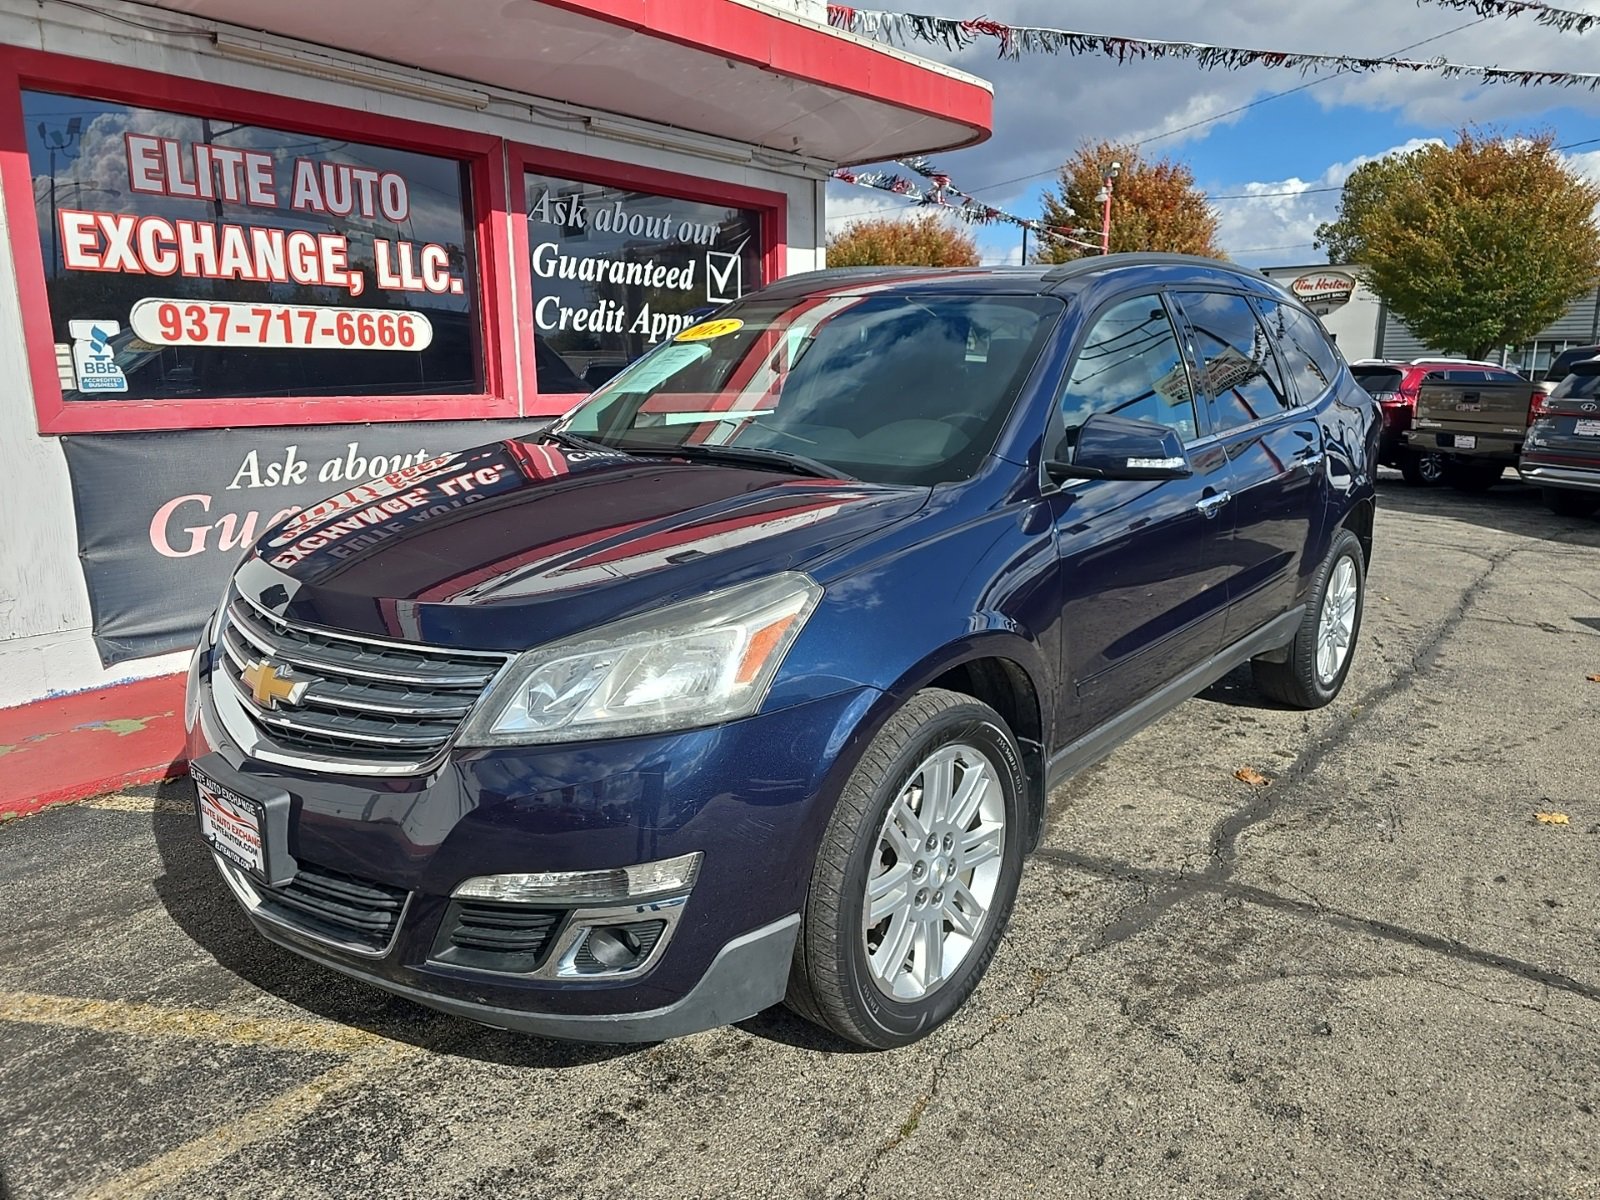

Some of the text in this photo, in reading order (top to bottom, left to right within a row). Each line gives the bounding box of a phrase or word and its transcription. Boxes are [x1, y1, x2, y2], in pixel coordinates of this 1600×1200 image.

[125, 132, 409, 223] ELITE AUTO
[527, 189, 721, 246] Ask about our
[58, 208, 464, 296] EXCHANGE, LLC.
[532, 242, 696, 291] Guaranteed
[1295, 278, 1314, 291] Tim
[157, 306, 416, 348] 937-717-6666
[535, 295, 625, 333] Credit
[84, 362, 118, 374] BBB
[1455, 403, 1482, 412] GMC
[226, 442, 430, 490] Ask about
[190, 768, 256, 815] ELITE AUTO EXCHANGE
[201, 804, 217, 821] ELITE
[217, 816, 231, 831] AUTO
